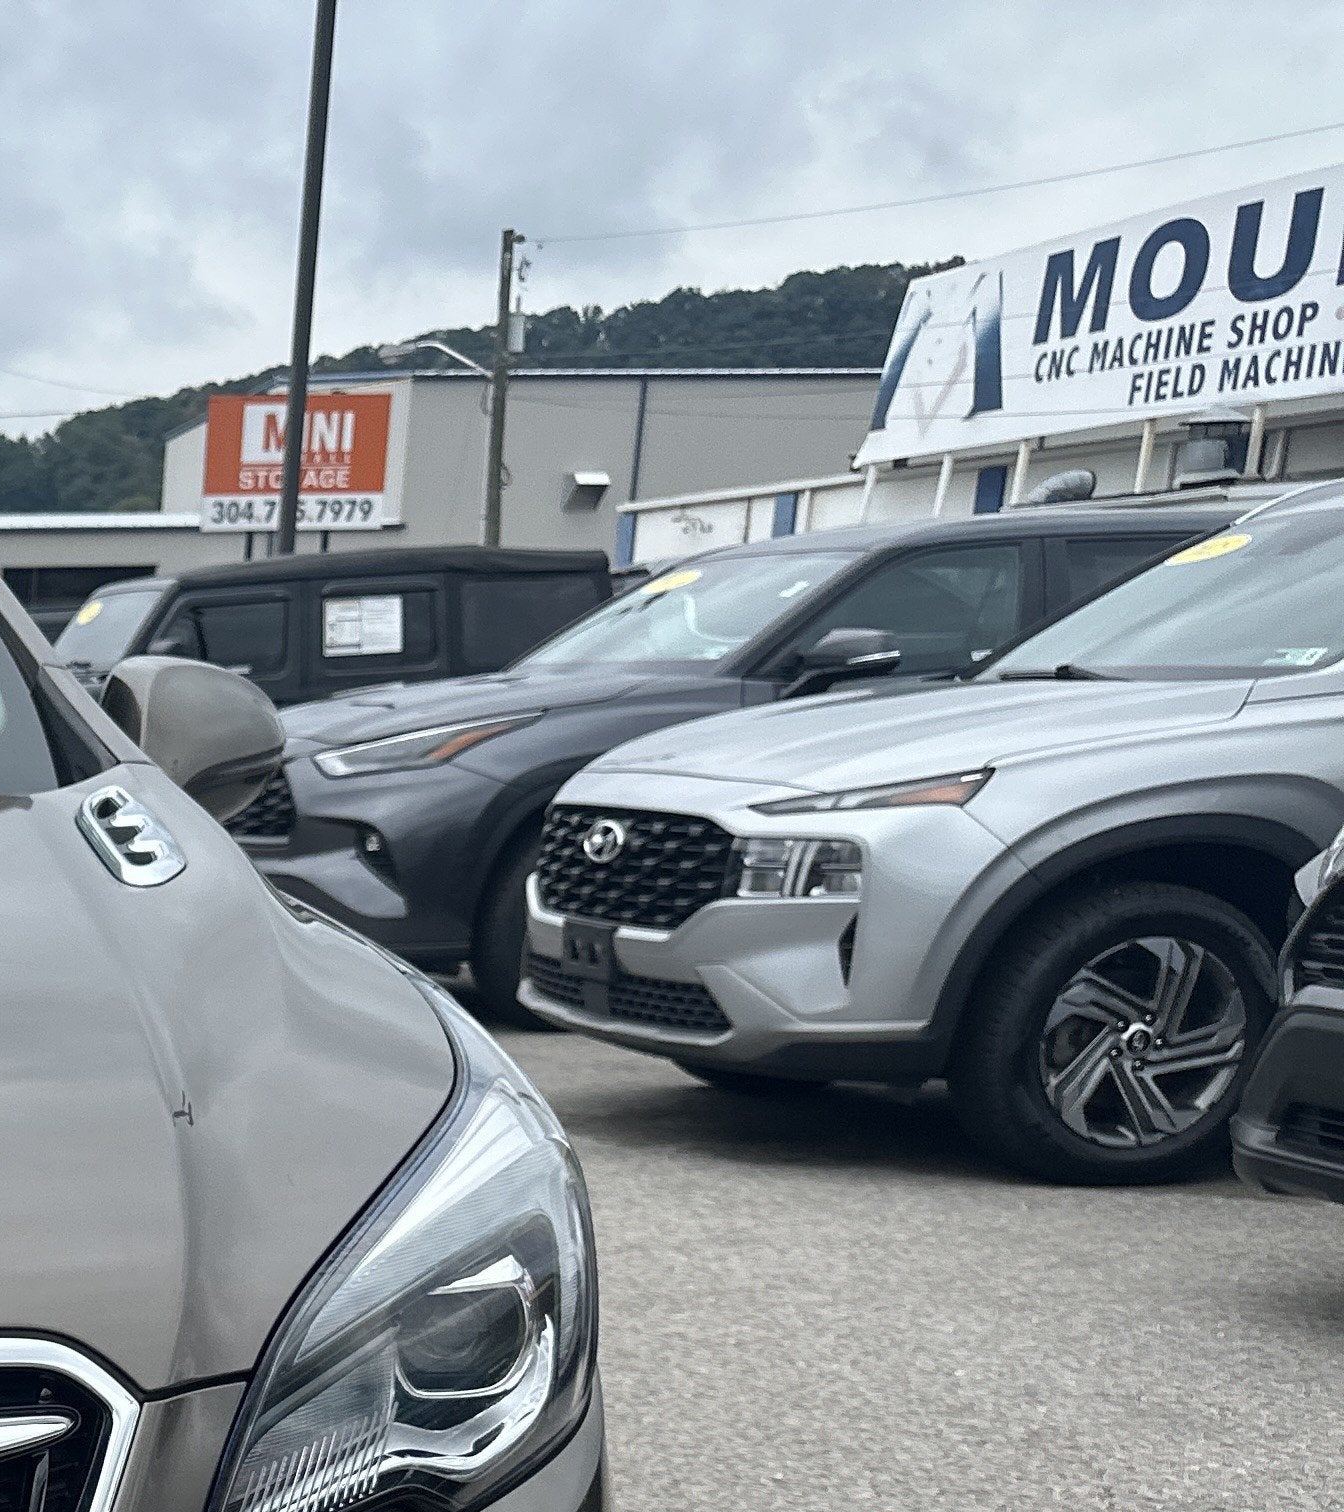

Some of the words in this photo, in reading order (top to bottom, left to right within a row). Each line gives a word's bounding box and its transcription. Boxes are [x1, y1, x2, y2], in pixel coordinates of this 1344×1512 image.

[1033, 187, 1344, 345] MOU
[1034, 346, 1080, 383] CNC
[1088, 320, 1216, 374] MACHINE
[1227, 301, 1319, 349] SHOP
[1128, 363, 1205, 405] FIELD
[1218, 341, 1344, 392] MACHIN
[238, 469, 350, 489] STOAGE
